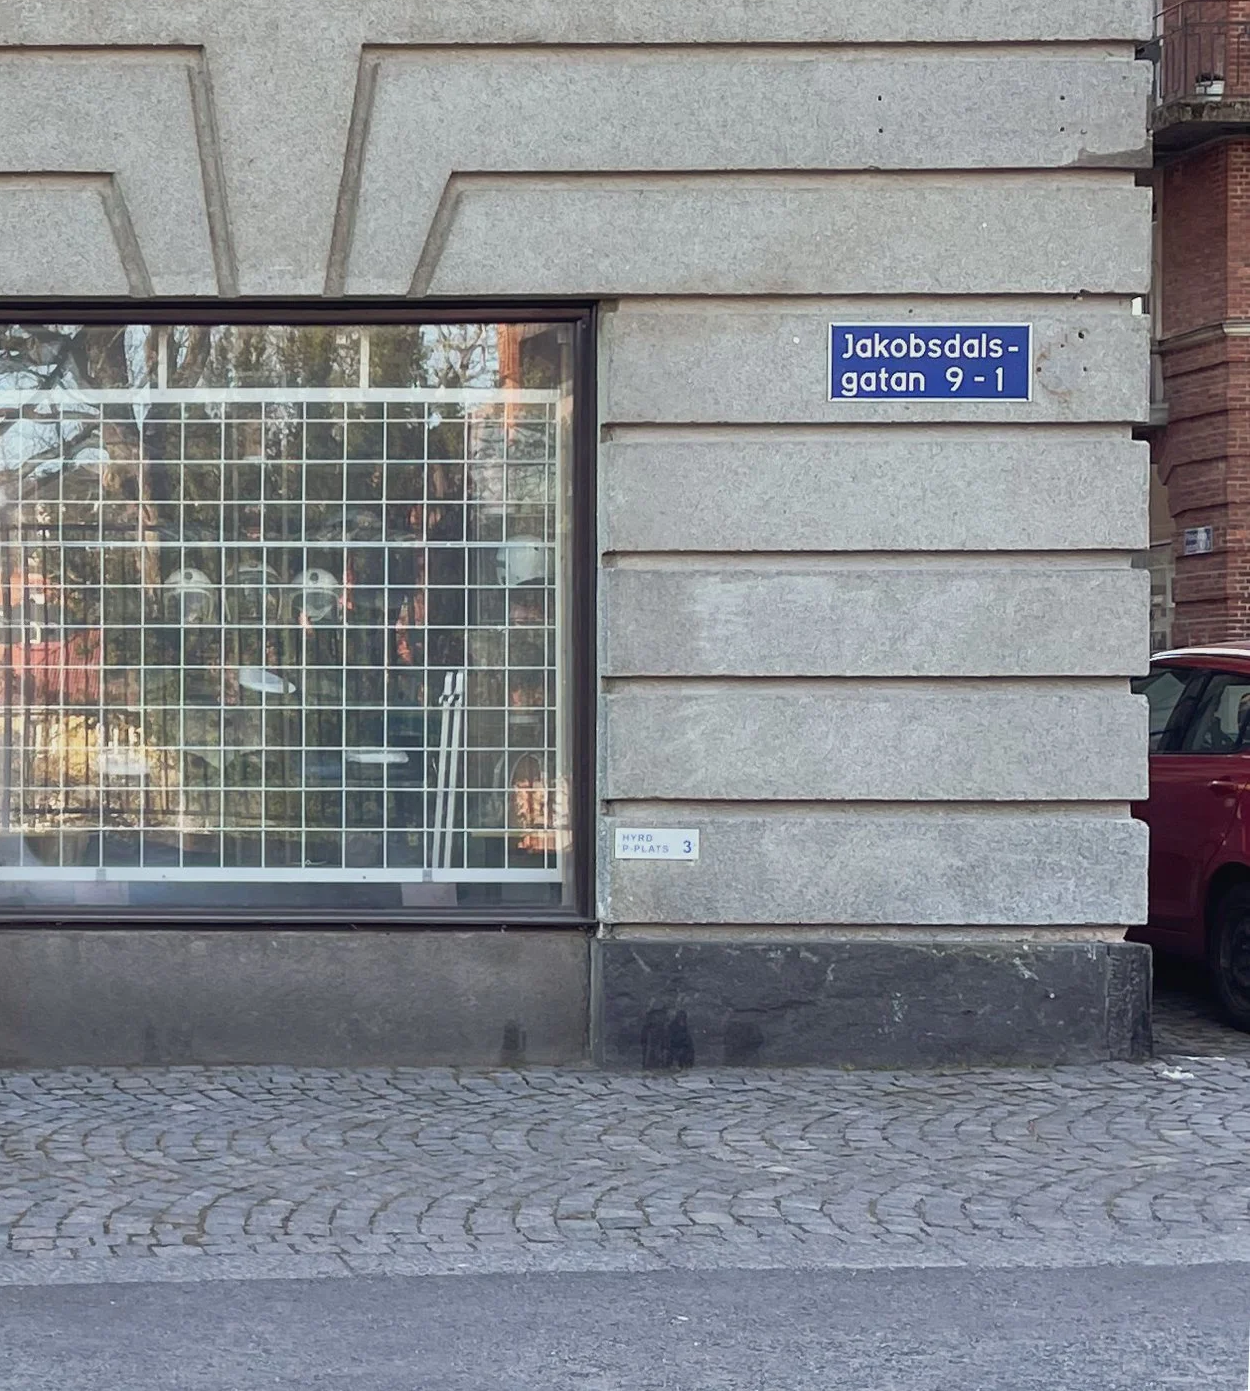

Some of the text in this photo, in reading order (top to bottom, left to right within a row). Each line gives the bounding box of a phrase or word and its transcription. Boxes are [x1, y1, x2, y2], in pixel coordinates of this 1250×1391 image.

[841, 333, 1019, 359] Jakobsdals-
[841, 367, 926, 397] gatan
[622, 834, 653, 842] HYRD
[682, 840, 692, 853] 3
